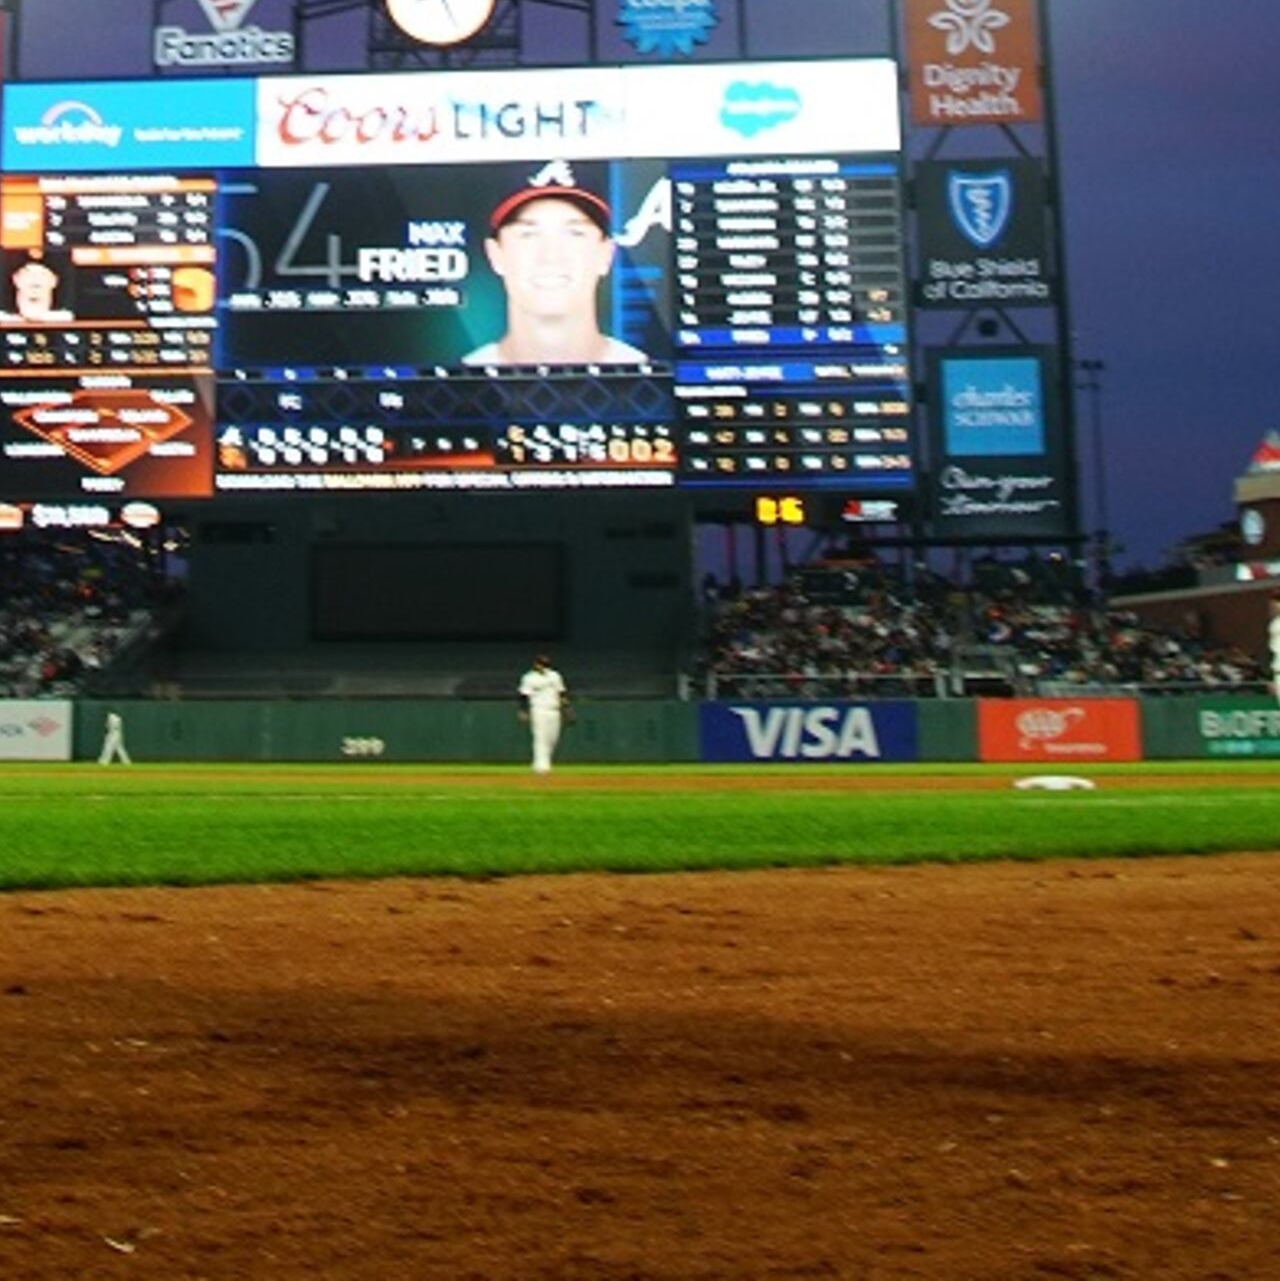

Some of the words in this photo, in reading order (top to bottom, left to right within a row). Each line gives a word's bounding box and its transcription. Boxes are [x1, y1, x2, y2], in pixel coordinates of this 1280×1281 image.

[158, 28, 292, 63] Fanatics
[924, 64, 1021, 94] Dignity
[277, 86, 440, 147] Coors
[454, 99, 595, 140] LIGHT
[929, 90, 1021, 117] Health
[408, 222, 467, 245] MAX
[357, 247, 468, 283] FRIED
[930, 259, 973, 278] Blue
[976, 259, 1040, 277] Shield
[924, 280, 949, 300] of
[952, 279, 1049, 300] California
[730, 706, 880, 759] VISA
